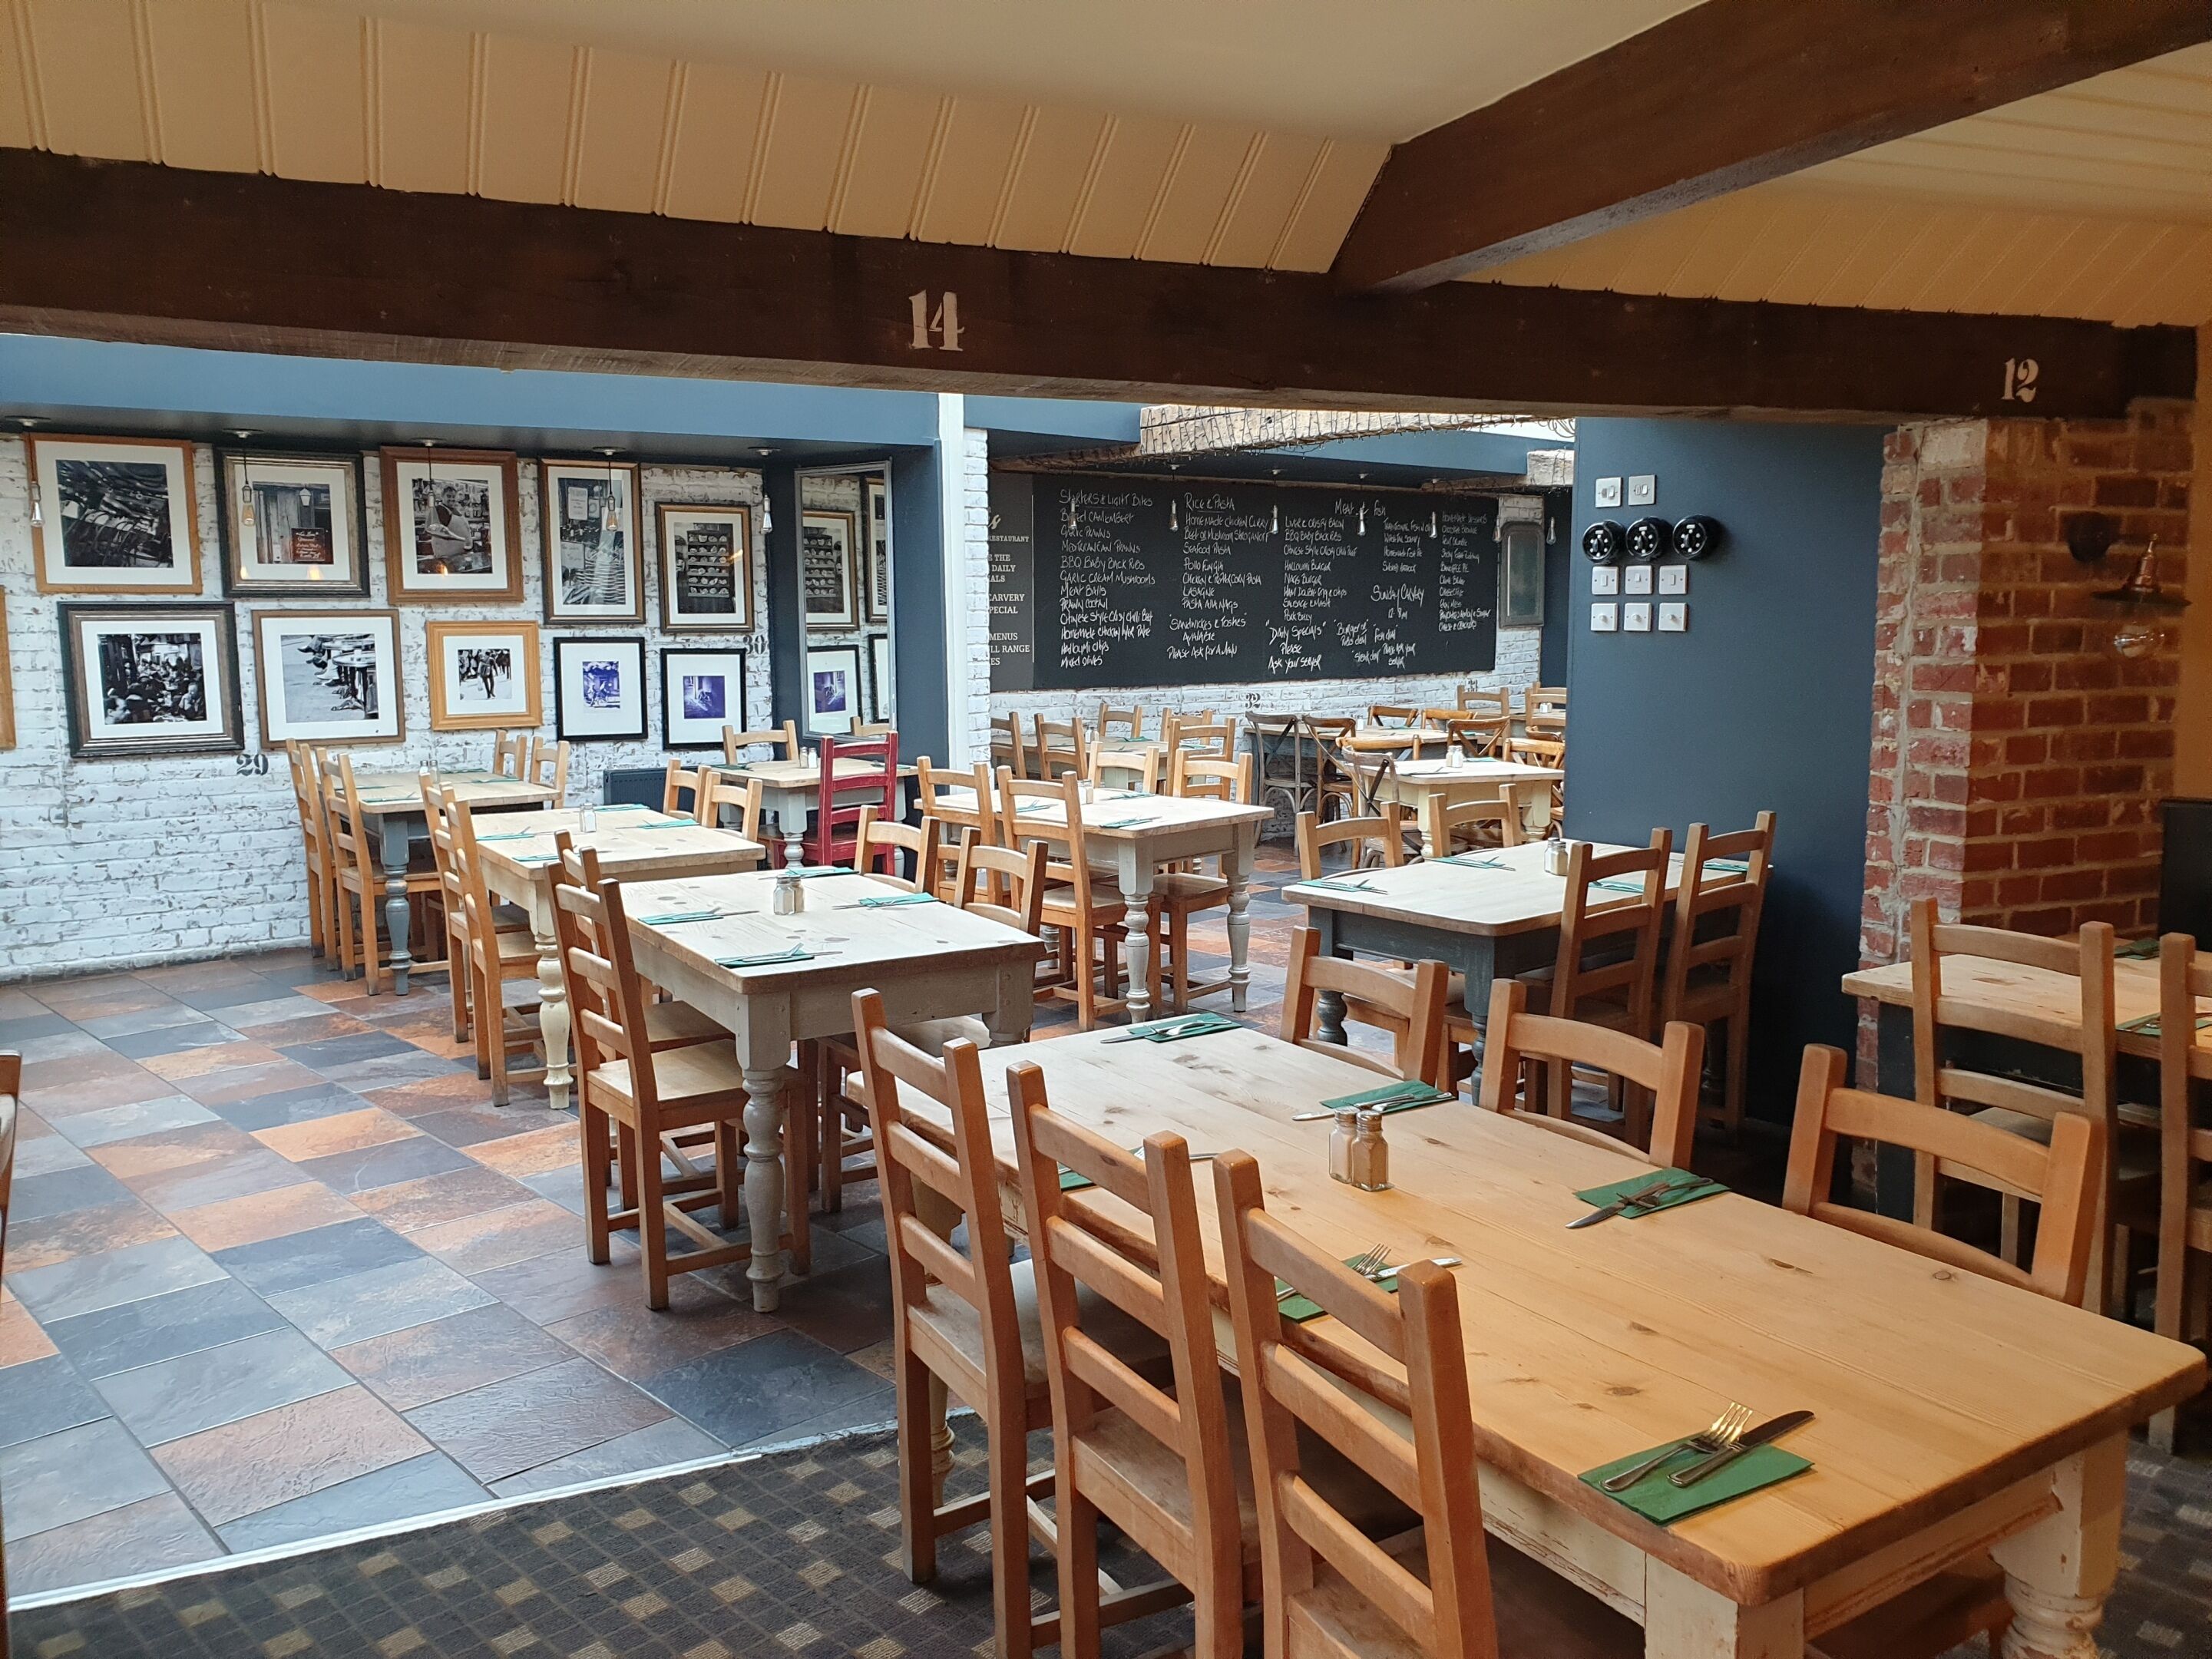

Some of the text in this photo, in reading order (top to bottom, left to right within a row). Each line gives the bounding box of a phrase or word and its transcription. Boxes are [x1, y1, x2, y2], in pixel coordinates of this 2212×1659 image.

[909, 289, 965, 352] 14
[2001, 358, 2039, 403] 12
[991, 564, 1016, 573] DAILY
[1060, 555, 1082, 569] BBQ
[1002, 645, 1030, 653] RANGE
[1245, 692, 1261, 709] 32
[236, 753, 269, 777] 29
